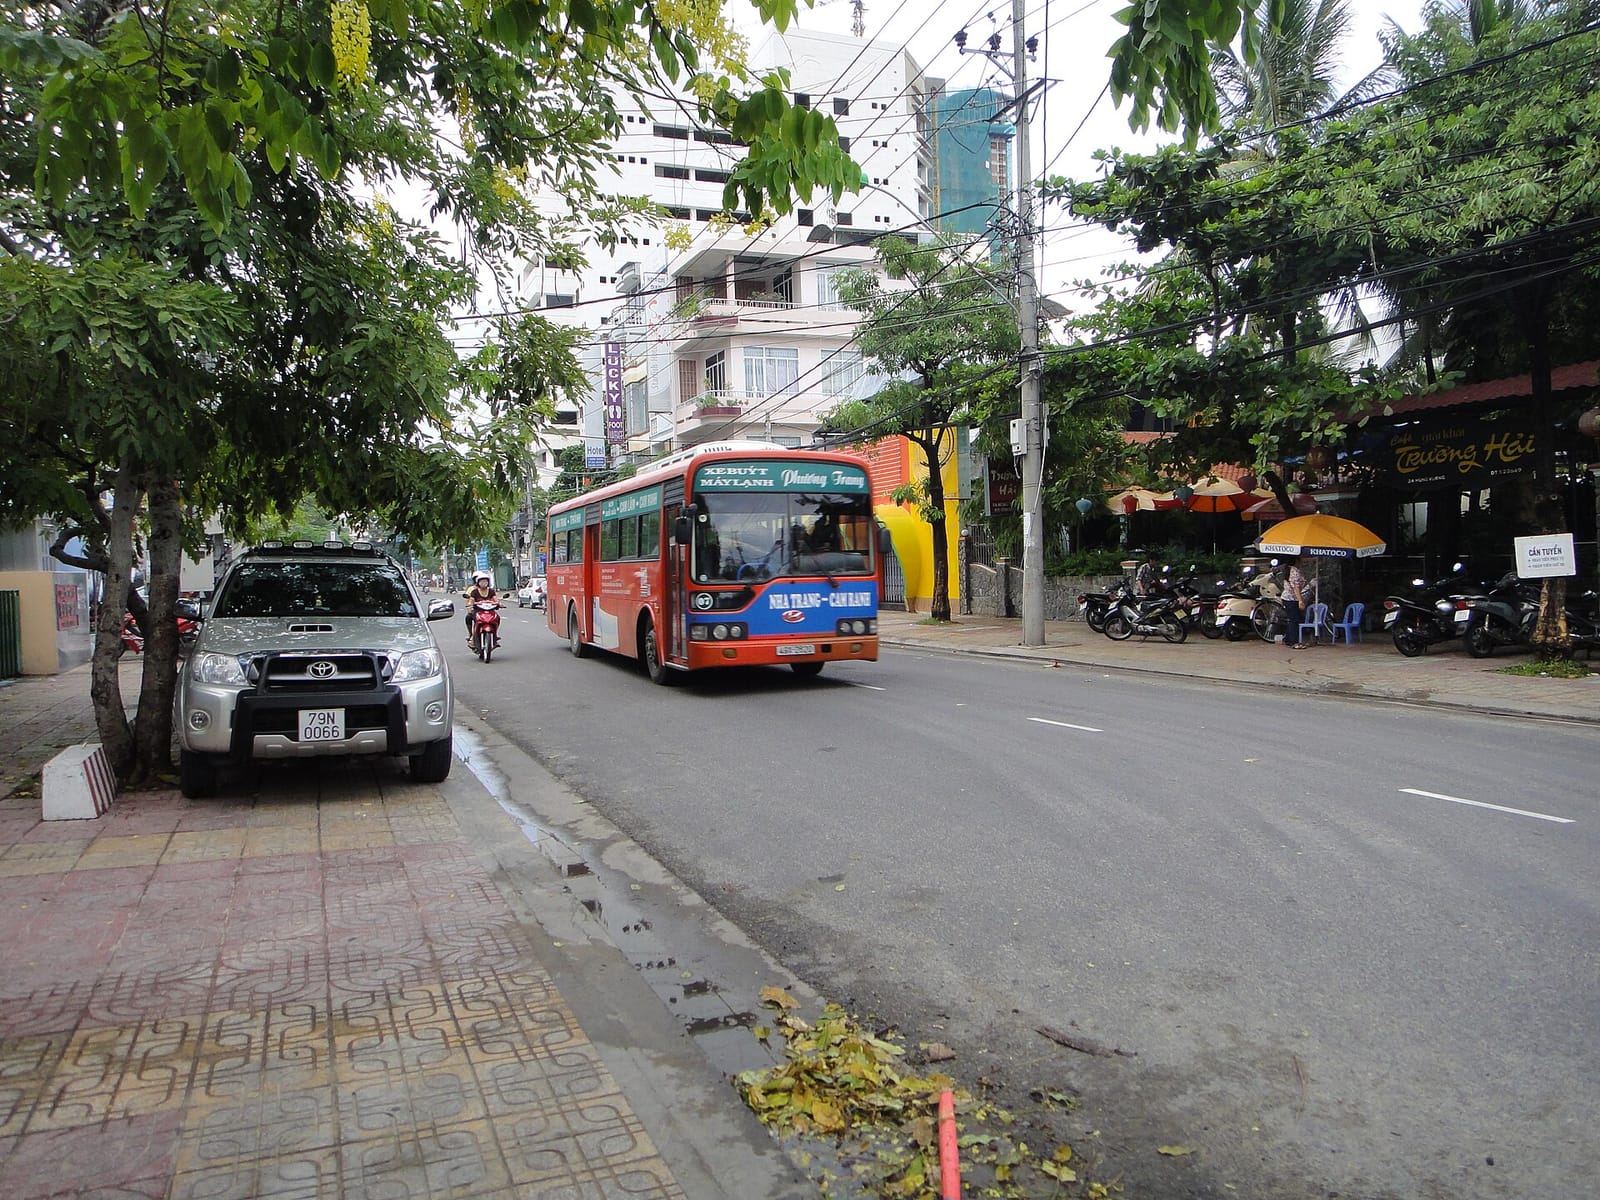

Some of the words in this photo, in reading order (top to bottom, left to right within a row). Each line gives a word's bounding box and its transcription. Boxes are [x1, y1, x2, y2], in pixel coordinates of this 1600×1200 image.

[607, 343, 620, 403] LUCKY
[608, 421, 624, 429] FOOT
[587, 446, 605, 455] Hotel
[1484, 432, 1536, 462] Hải
[1264, 545, 1295, 553] KHATOCO
[1310, 548, 1347, 557] KHATOCO
[769, 594, 790, 609] NHA
[790, 593, 821, 608] TRANG
[308, 712, 336, 726] 79N
[304, 726, 340, 739] 0066
